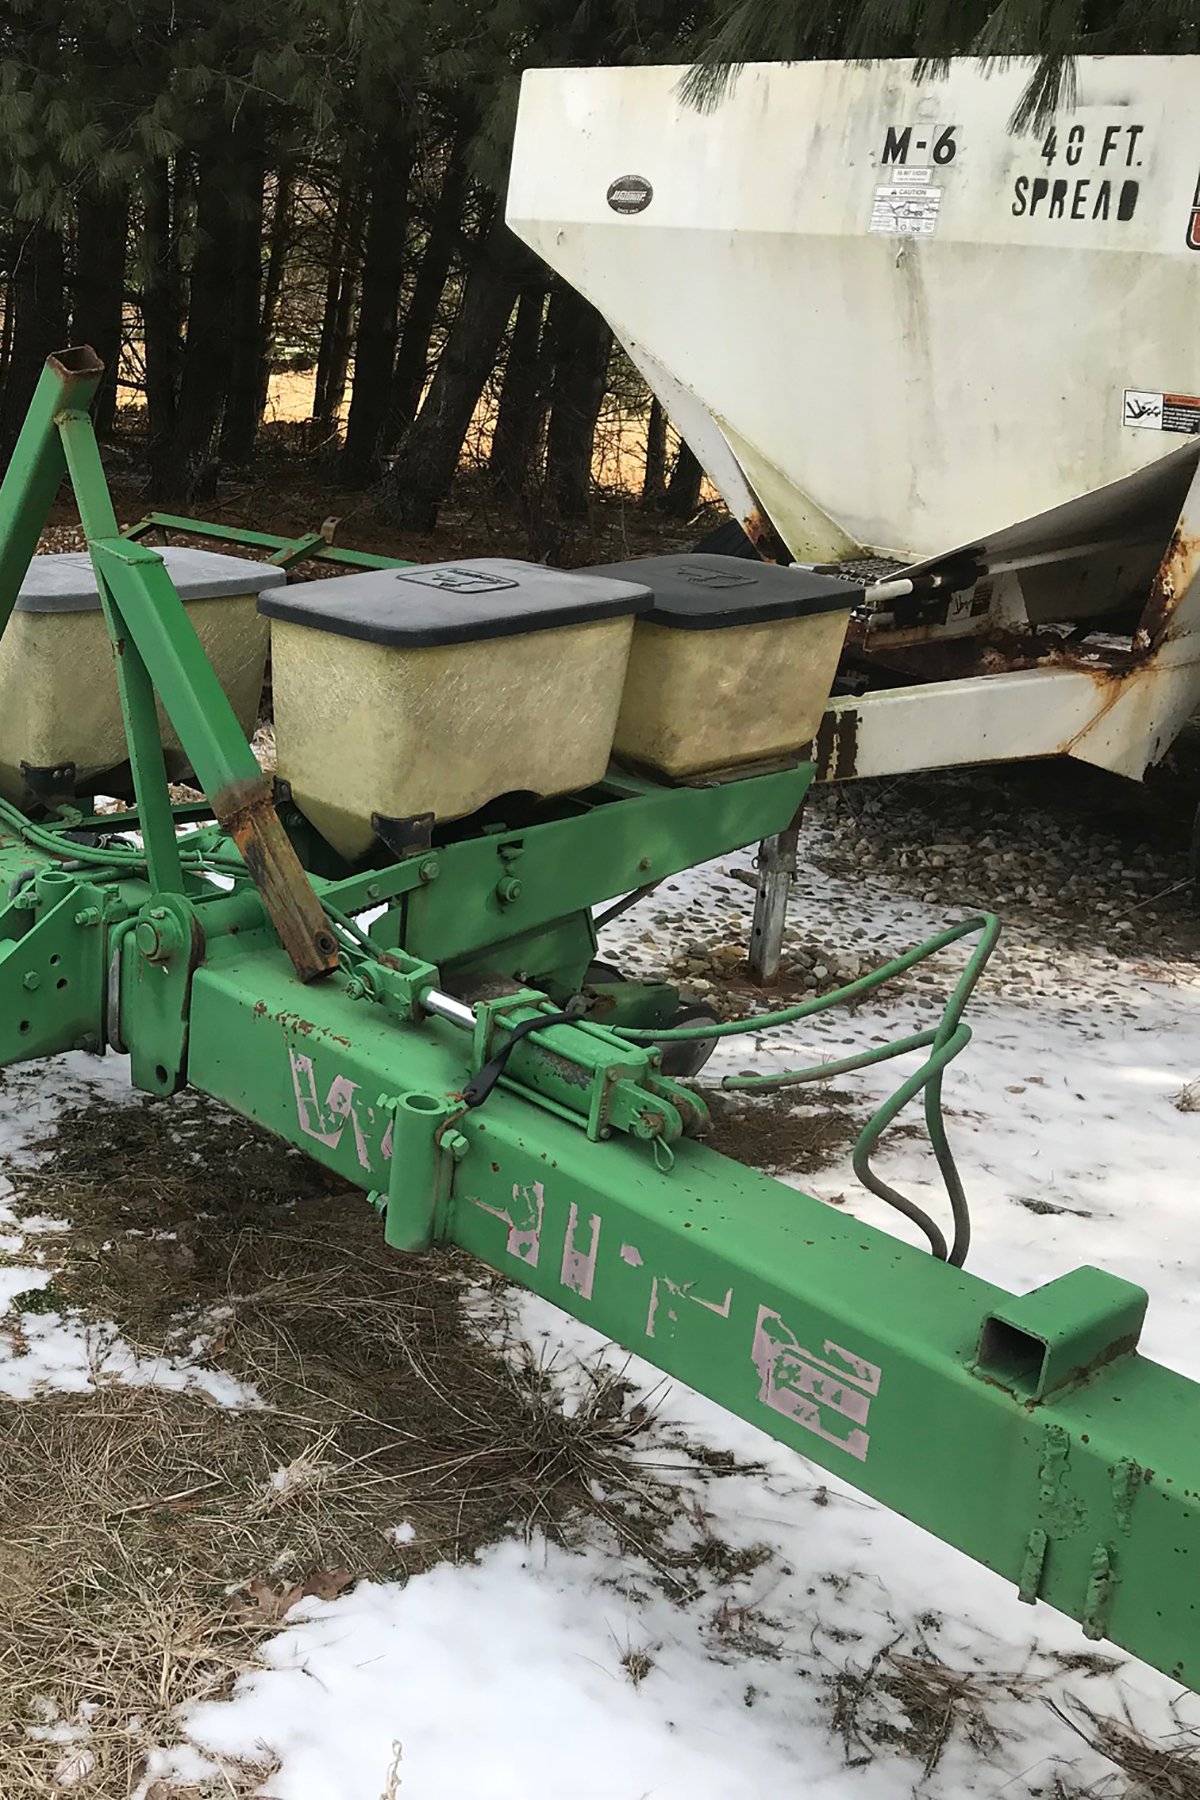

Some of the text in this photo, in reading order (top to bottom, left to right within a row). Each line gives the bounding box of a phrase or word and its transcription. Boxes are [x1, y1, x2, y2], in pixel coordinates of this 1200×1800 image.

[881, 125, 957, 165] M-6
[1041, 124, 1144, 167] 40 FT.
[898, 188, 927, 196] CAUTION
[1011, 175, 1140, 222] SPREAD
